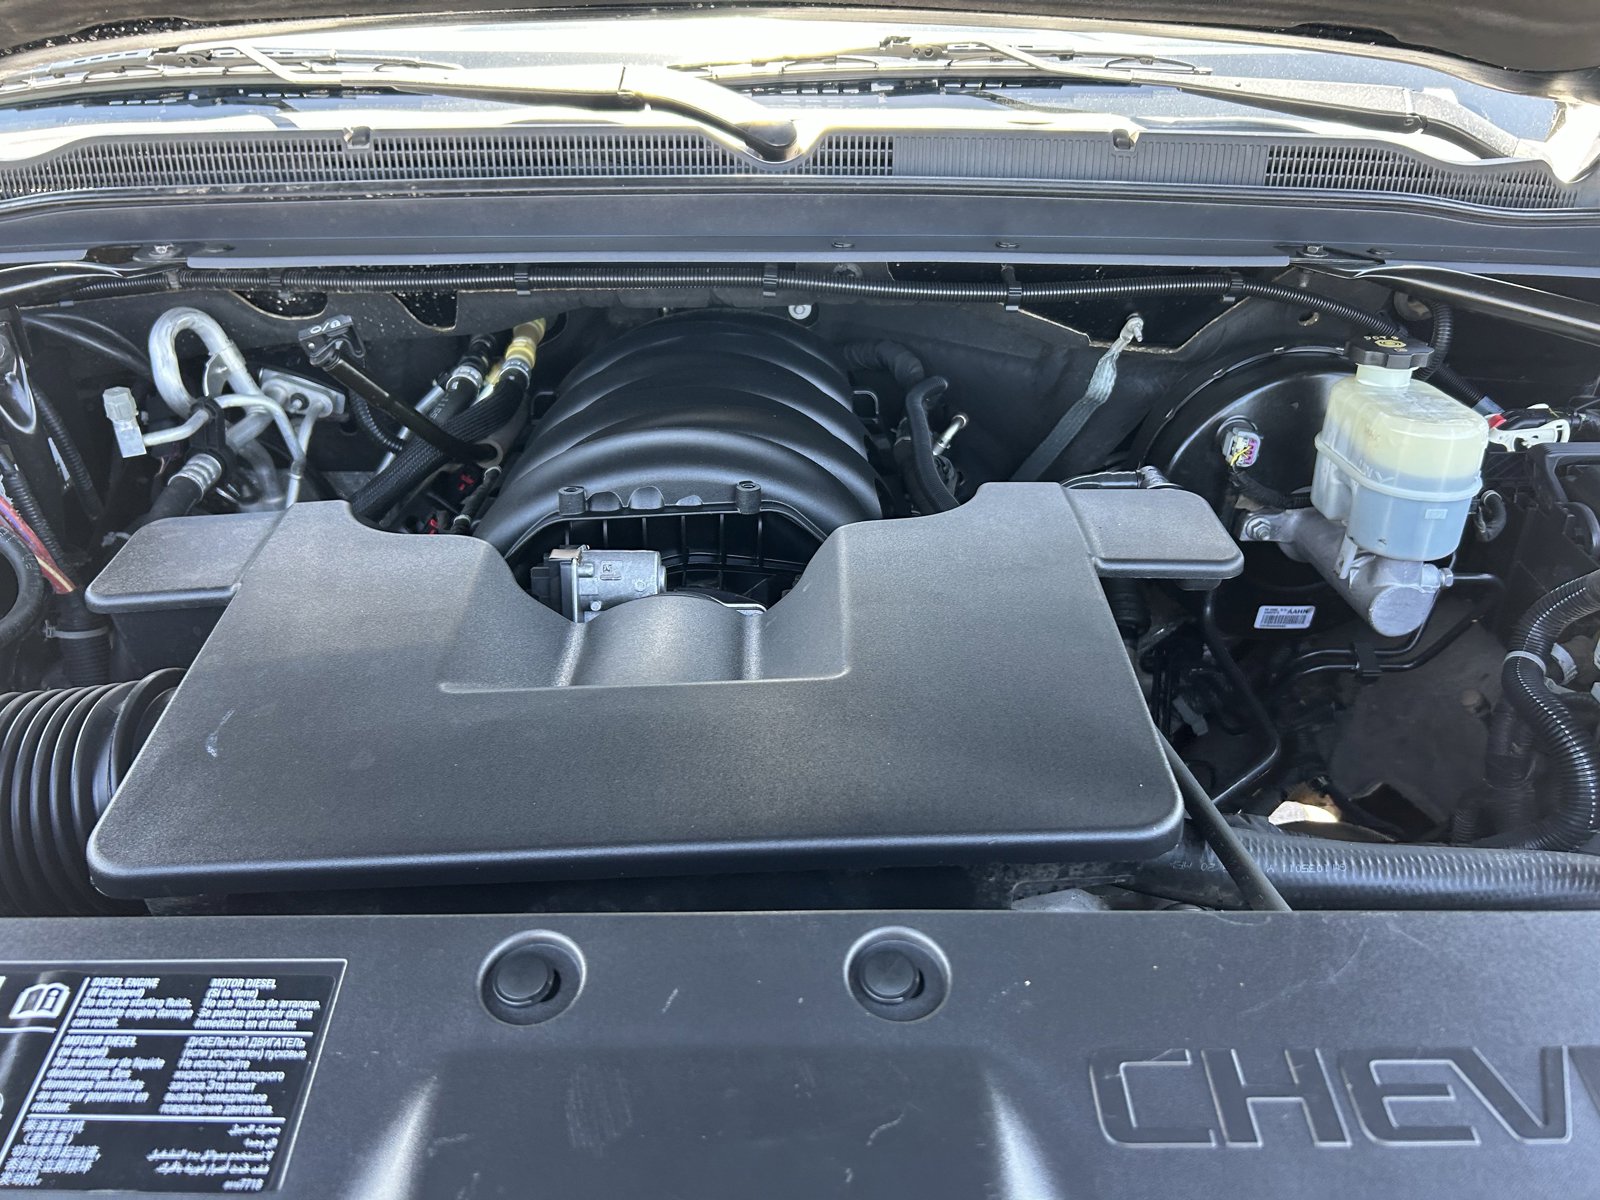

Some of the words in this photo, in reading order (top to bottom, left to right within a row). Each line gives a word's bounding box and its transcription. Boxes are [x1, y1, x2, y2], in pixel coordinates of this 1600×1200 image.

[90, 977, 124, 987] DIESEL
[124, 978, 160, 988] ENGINE
[210, 978, 244, 988] MOTOR
[245, 979, 276, 989] DIESEL
[206, 988, 220, 998] (Si
[232, 989, 259, 998] tiene)
[96, 998, 112, 1007] not
[112, 999, 129, 1008] use
[130, 998, 164, 1009] starting
[201, 998, 216, 1008] No
[217, 999, 234, 1008] use
[235, 999, 267, 1008] fluidos
[267, 999, 279, 1008] de
[279, 1000, 321, 1010] arranque.
[125, 1009, 156, 1020] engine
[156, 1009, 194, 1021] damage
[197, 1008, 212, 1018] Se
[212, 1009, 246, 1019] pueden
[247, 1009, 285, 1019] producir
[286, 1010, 313, 1020] daños
[71, 1019, 90, 1027] can
[245, 1020, 257, 1029] en
[258, 1020, 267, 1029] el
[268, 1020, 297, 1029] motor.
[61, 1035, 104, 1046] MOTEUR
[104, 1036, 137, 1047] DIESEL
[185, 1036, 249, 1048] ДИЗЕЛЬНЫЙ
[249, 1037, 306, 1049] ДВИГАТЕЛЬ
[182, 1048, 208, 1059] (если
[208, 1049, 264, 1061] установлен)
[264, 1050, 307, 1061] пусковые
[177, 1059, 193, 1069] Не
[193, 1059, 250, 1071] используйте
